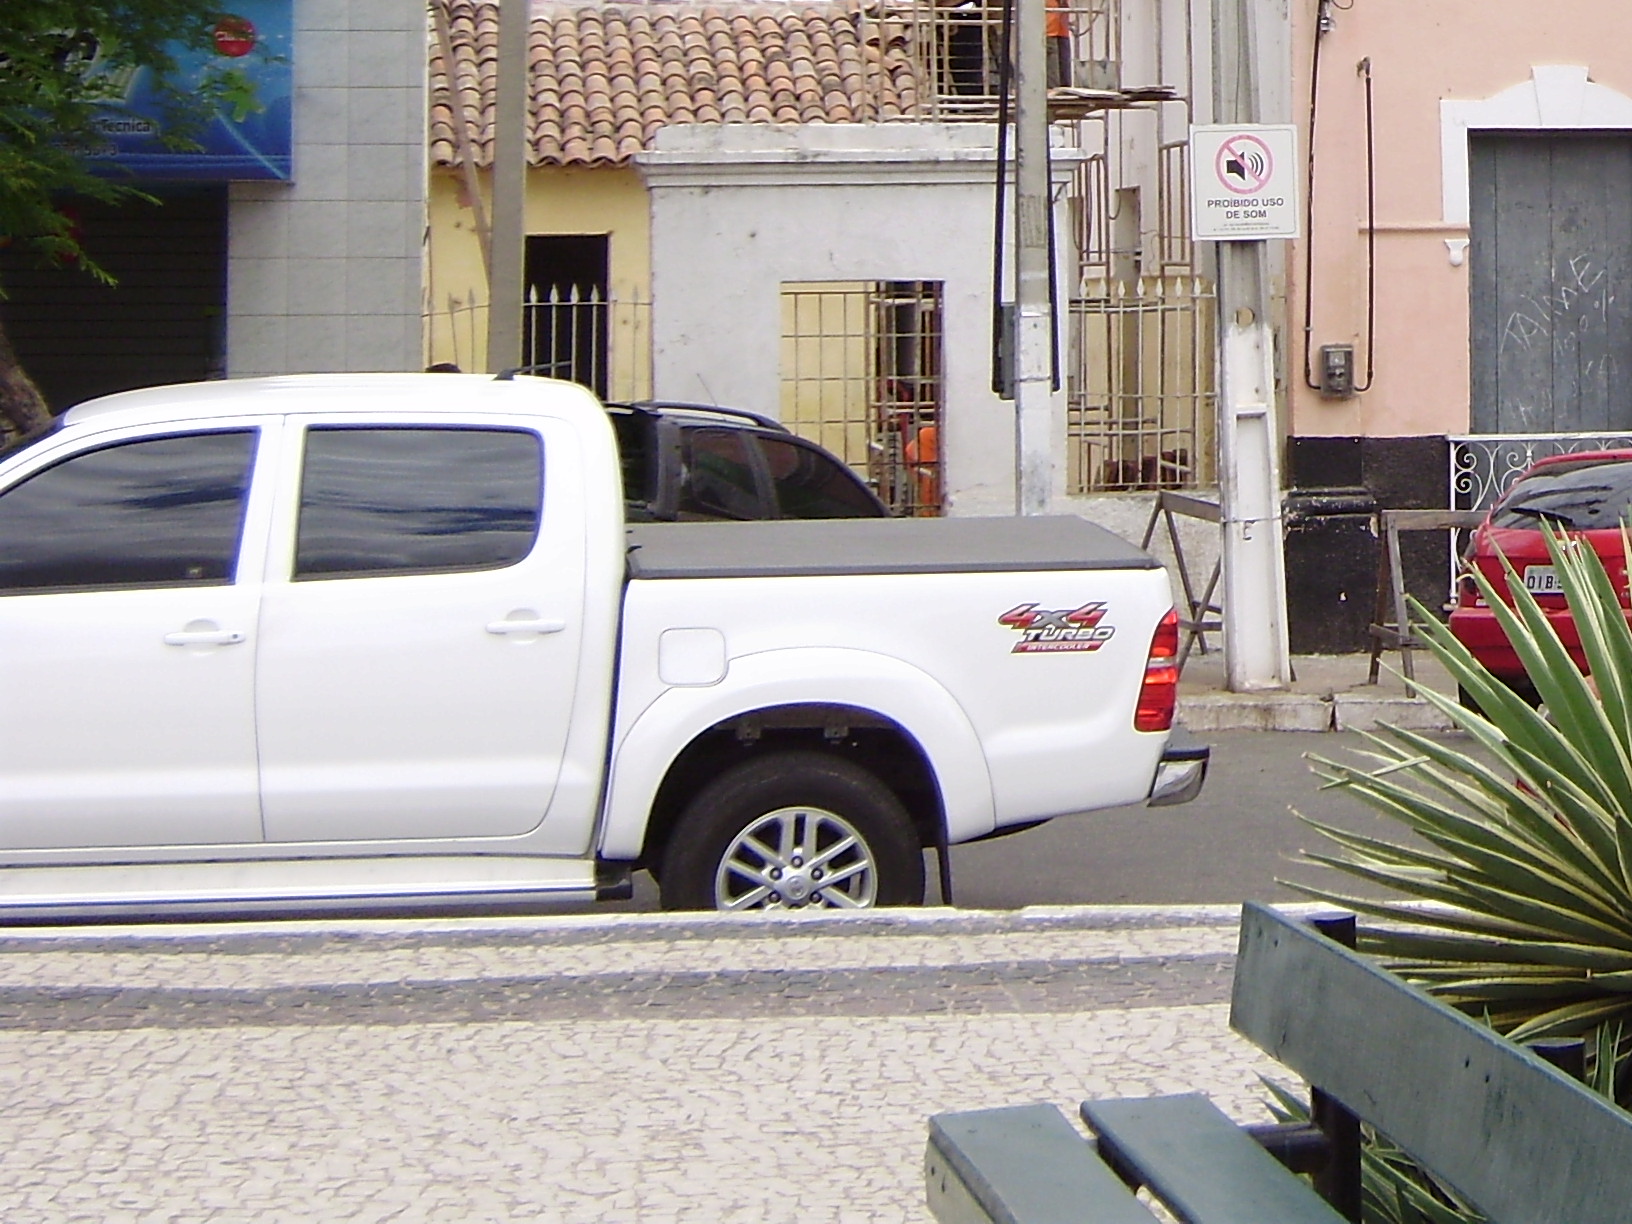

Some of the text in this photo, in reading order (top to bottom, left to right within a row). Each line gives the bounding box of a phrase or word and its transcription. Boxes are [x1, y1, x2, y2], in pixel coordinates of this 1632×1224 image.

[1262, 197, 1284, 207] USO
[1226, 210, 1267, 219] DE SOM
[1023, 626, 1116, 641] TURBO
